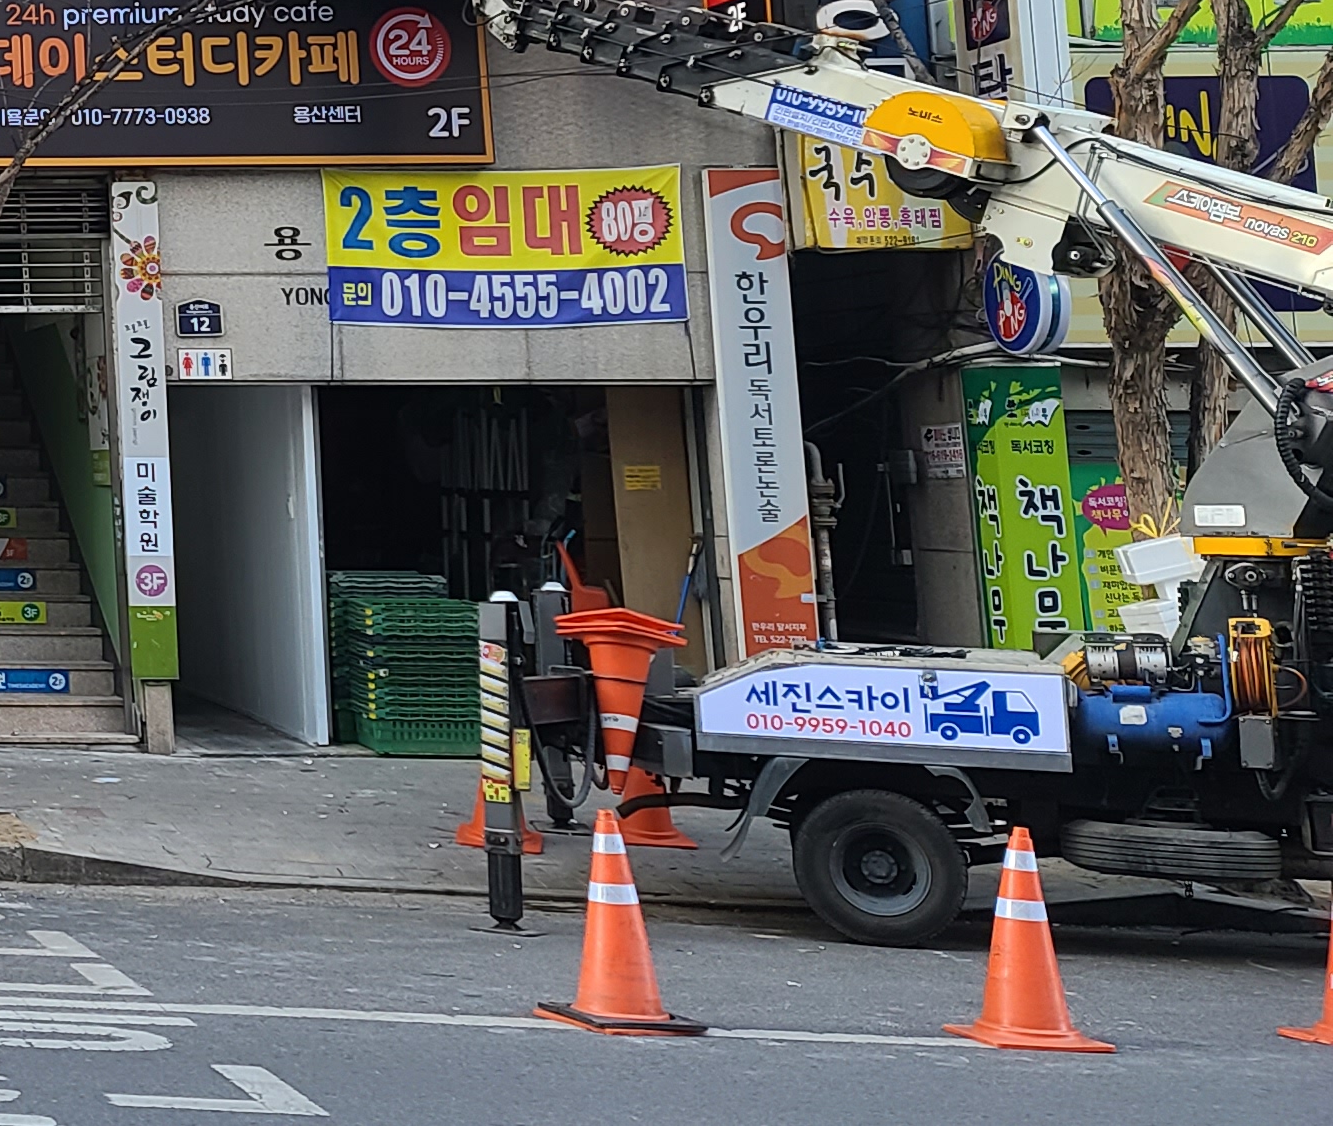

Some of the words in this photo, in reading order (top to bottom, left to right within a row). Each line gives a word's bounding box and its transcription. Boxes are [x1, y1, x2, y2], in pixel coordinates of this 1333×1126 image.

[5, 2, 56, 27] 24h
[62, 1, 181, 32] premium
[387, 28, 431, 56] 24
[391, 55, 430, 67] HOURS
[70, 105, 212, 127] 010-7773-0938
[293, 104, 363, 126] 용산센터
[427, 106, 471, 140] 2F
[338, 185, 442, 259] 2층
[451, 183, 586, 258] 임대
[1243, 216, 1291, 240] novas
[1289, 232, 1318, 248] 210
[264, 225, 313, 261] 용
[341, 282, 373, 307] 문의
[380, 267, 672, 320] 010-4555-4002
[190, 316, 211, 333] 12
[734, 270, 773, 376] 한우리
[747, 378, 781, 523] 독서토론논술
[1010, 439, 1055, 456] 독서코칭
[136, 462, 163, 554] 미술학원
[138, 570, 166, 591] 3F
[23, 606, 38, 619] 3F
[743, 679, 913, 716] 세진스카이
[745, 714, 914, 739] 010-9959-1040
